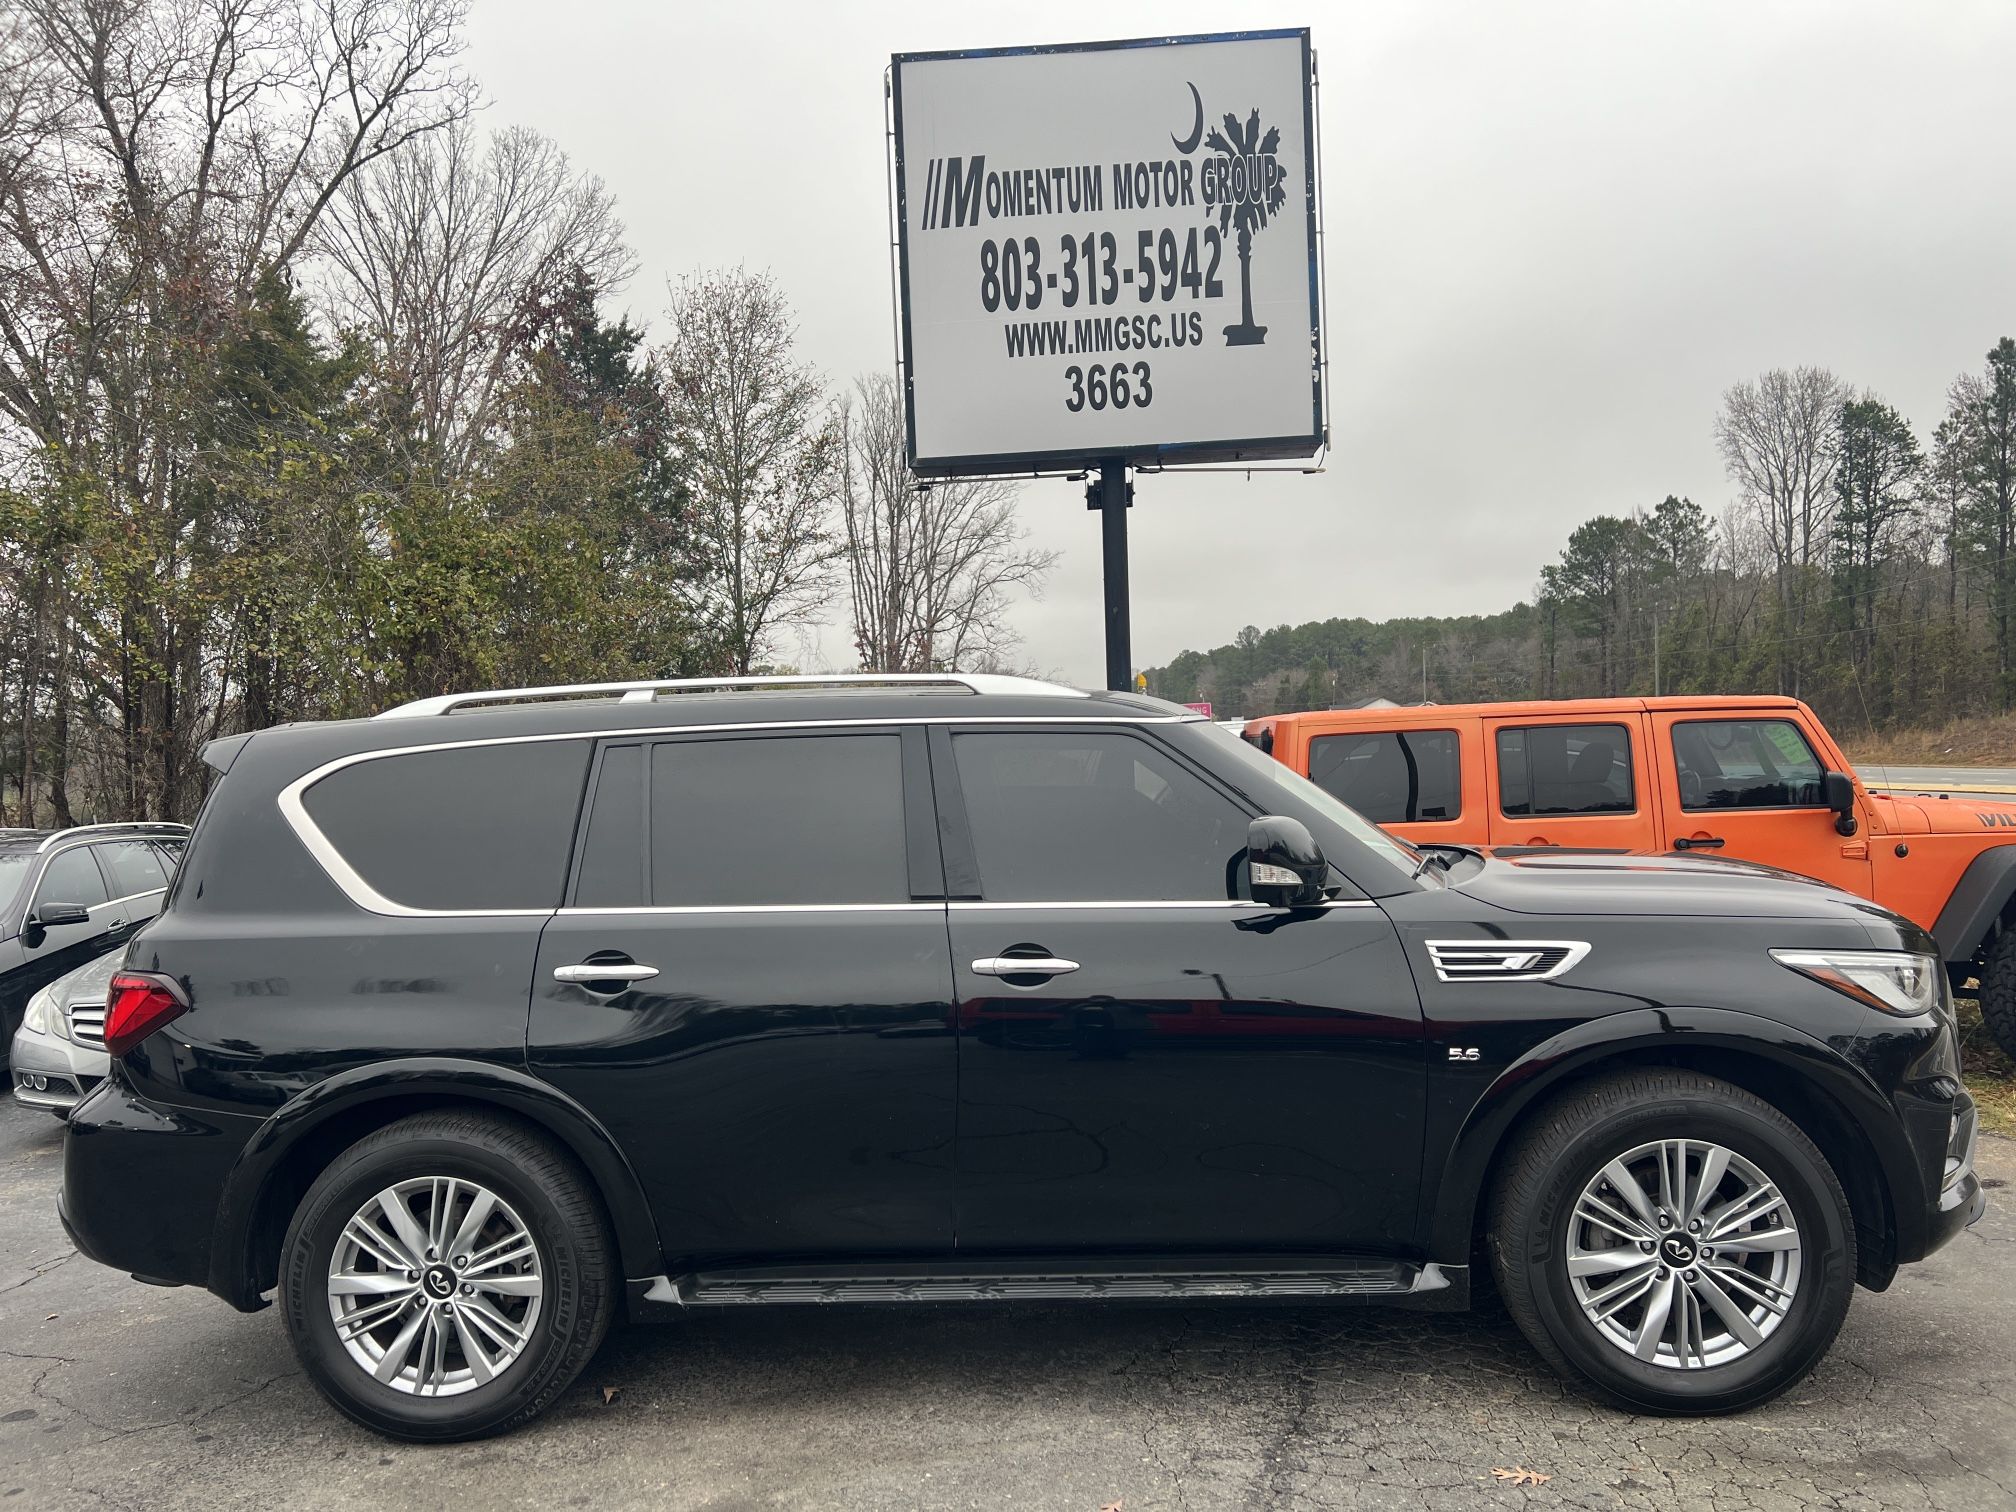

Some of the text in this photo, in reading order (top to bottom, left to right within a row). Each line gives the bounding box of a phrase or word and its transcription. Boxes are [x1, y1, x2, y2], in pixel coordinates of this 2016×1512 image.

[1113, 159, 1195, 210] MOTOR
[1200, 152, 1279, 206] GROUP
[980, 225, 1224, 313] 803-313-5942
[1004, 311, 1203, 358] WWW.MMGSC.US
[1065, 361, 1153, 412] 3663
[555, 1246, 572, 1329] MICHELIN
